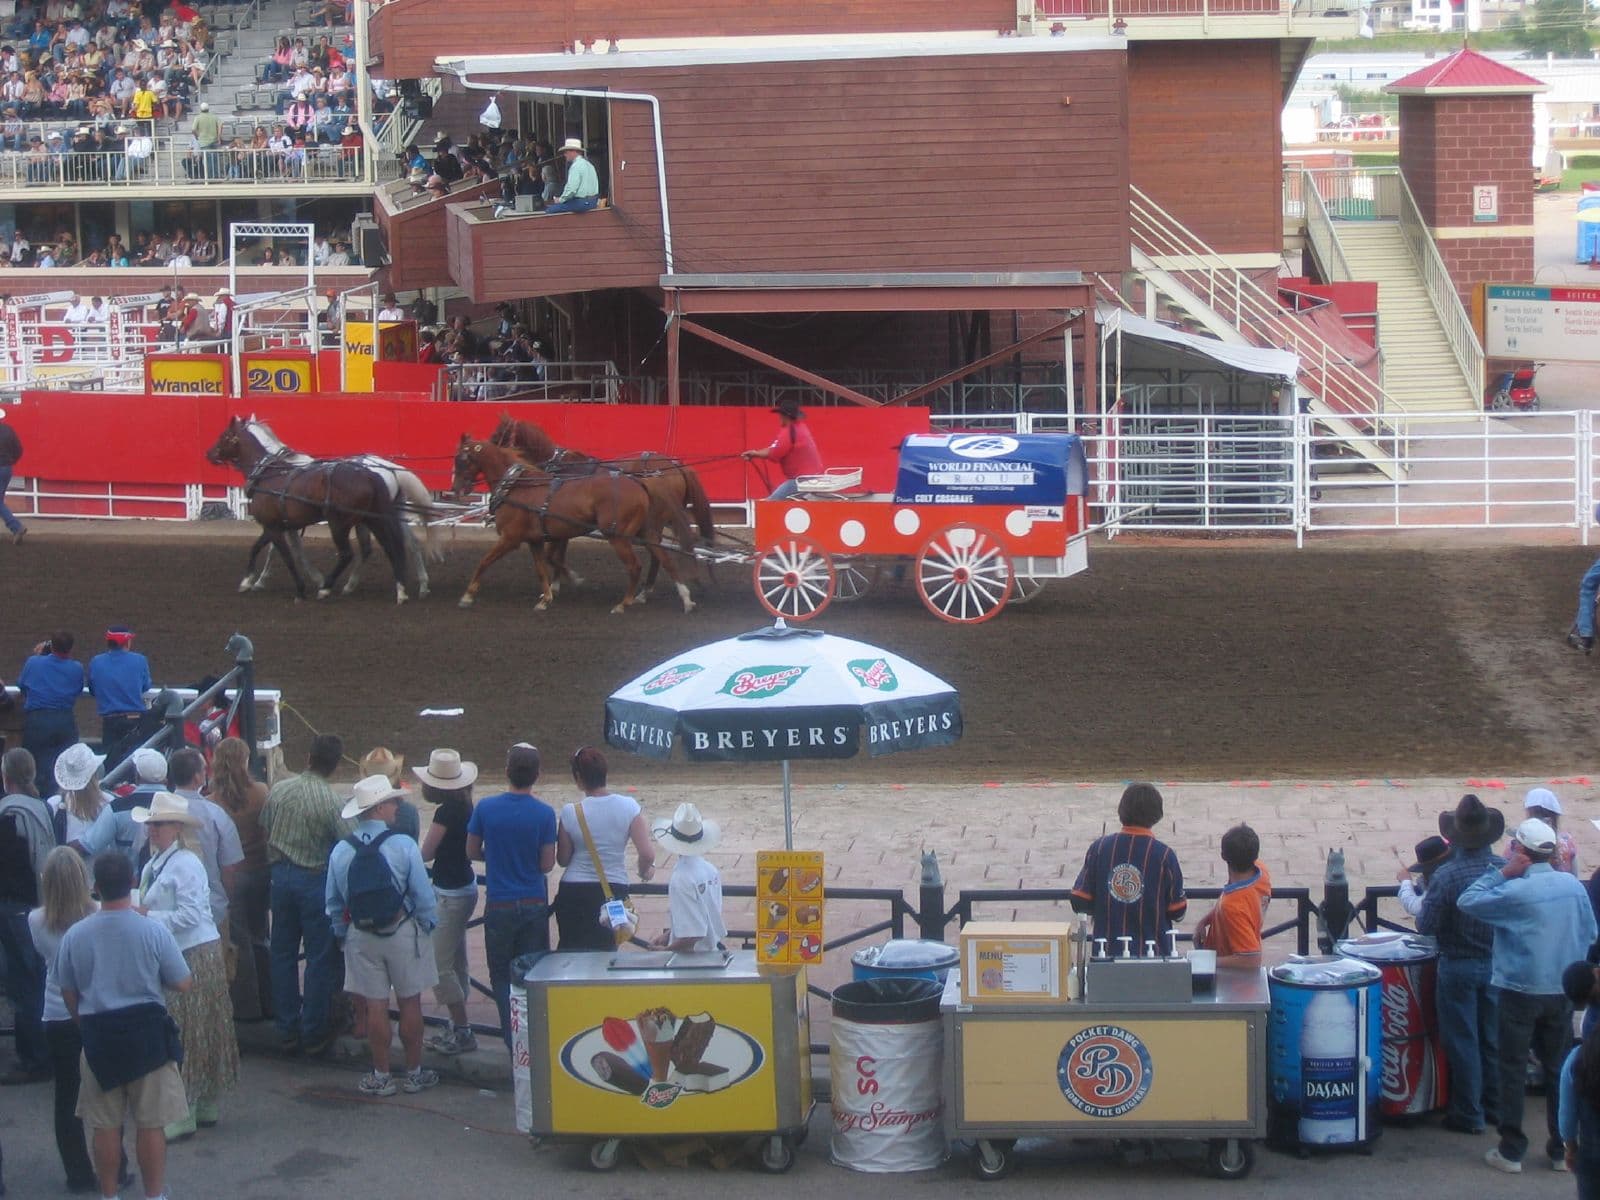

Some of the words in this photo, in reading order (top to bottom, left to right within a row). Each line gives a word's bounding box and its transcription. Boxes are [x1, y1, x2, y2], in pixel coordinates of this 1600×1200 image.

[346, 341, 374, 355] Wra
[152, 378, 222, 393] Wrangler
[248, 368, 301, 393] 20
[928, 462, 971, 472] WORLD
[972, 462, 1034, 472] FINANCIAL
[931, 474, 1030, 483] GROUP
[732, 668, 800, 695] Breyers
[870, 712, 952, 743] BREYERS
[694, 726, 848, 750] BREYERS
[979, 951, 1003, 960] MENU
[1070, 1026, 1109, 1047] POCKET
[1112, 1027, 1140, 1048] DAWG
[1306, 1081, 1355, 1099] DASANI
[1064, 1087, 1083, 1109] HOME
[1084, 1105, 1095, 1114] OF
[1097, 1108, 1114, 1116] THE
[1115, 1087, 1147, 1114] ORIGINAL
